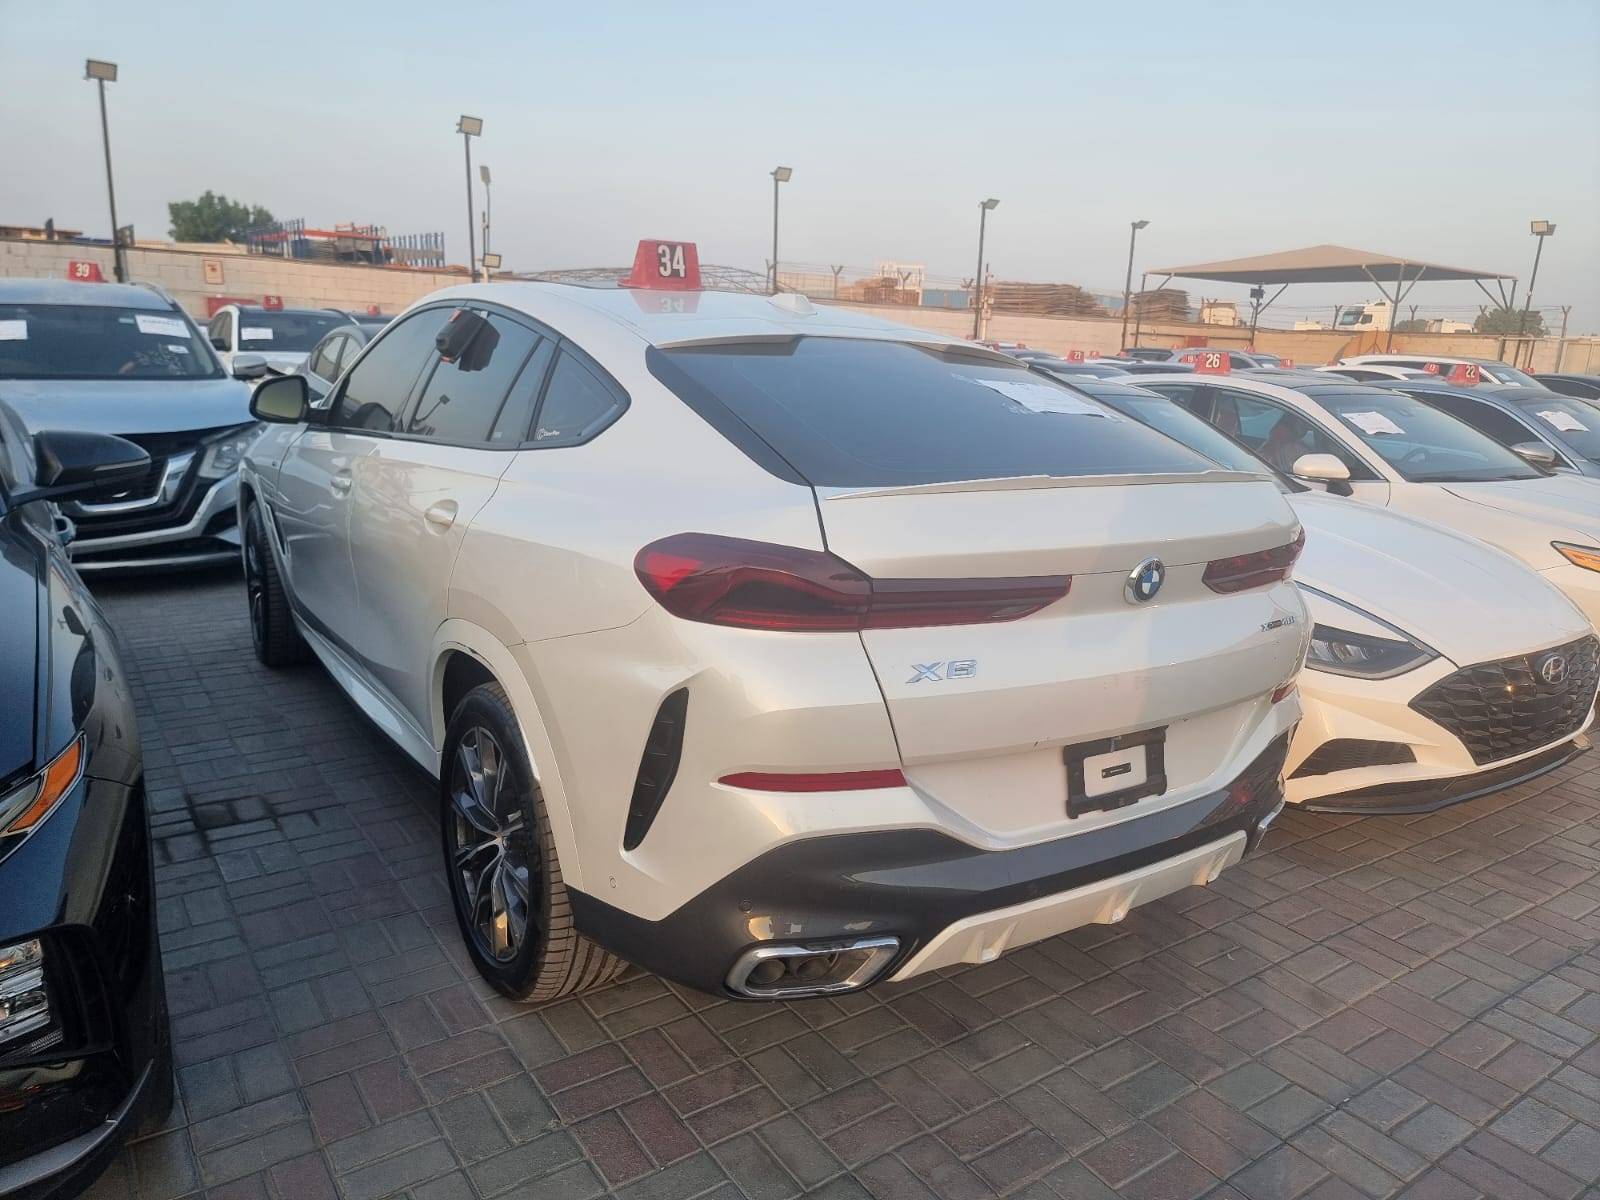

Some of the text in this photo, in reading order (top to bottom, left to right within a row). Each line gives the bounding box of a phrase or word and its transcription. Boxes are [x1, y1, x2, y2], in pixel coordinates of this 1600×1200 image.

[658, 245, 685, 277] 34
[75, 263, 90, 278] 39
[1205, 353, 1221, 368] 26
[1465, 366, 1476, 379] 22
[905, 660, 977, 684] X6
